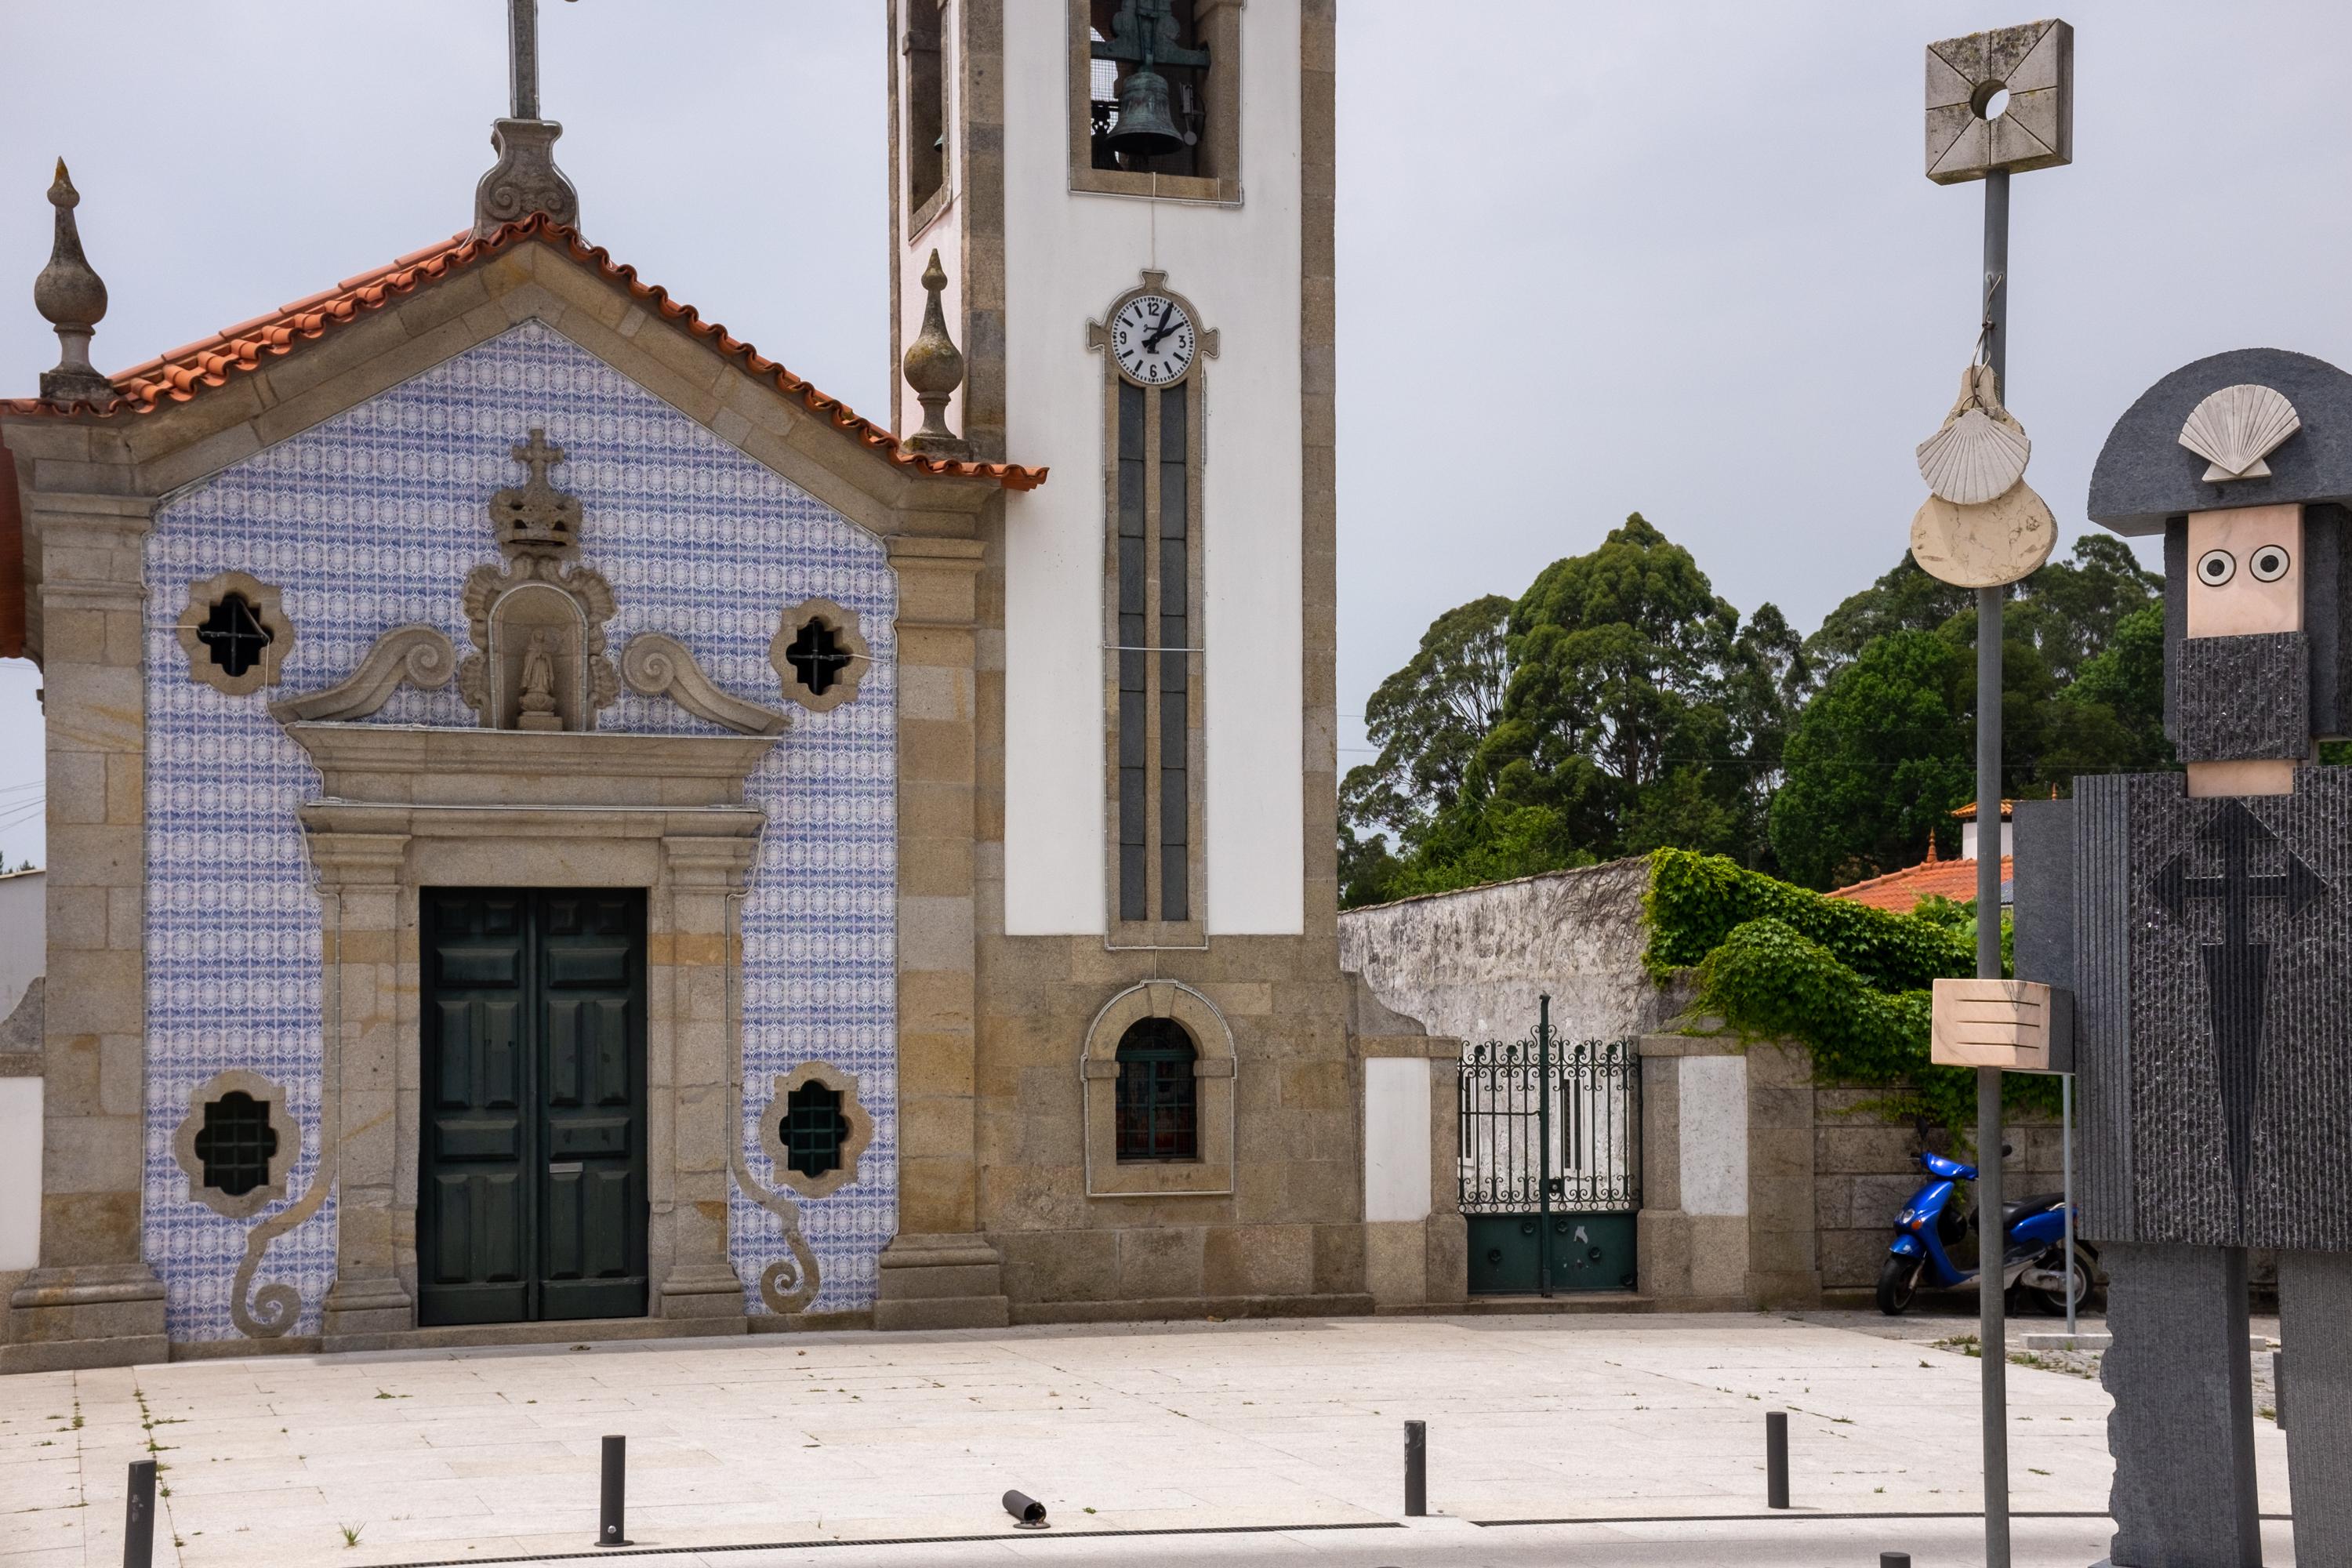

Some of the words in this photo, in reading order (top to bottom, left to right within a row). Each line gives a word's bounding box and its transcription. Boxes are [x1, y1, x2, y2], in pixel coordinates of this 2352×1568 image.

[1147, 302, 1160, 316] 12
[1120, 331, 1127, 344] 9
[1178, 335, 1186, 348] 3
[1149, 364, 1157, 377] 6
